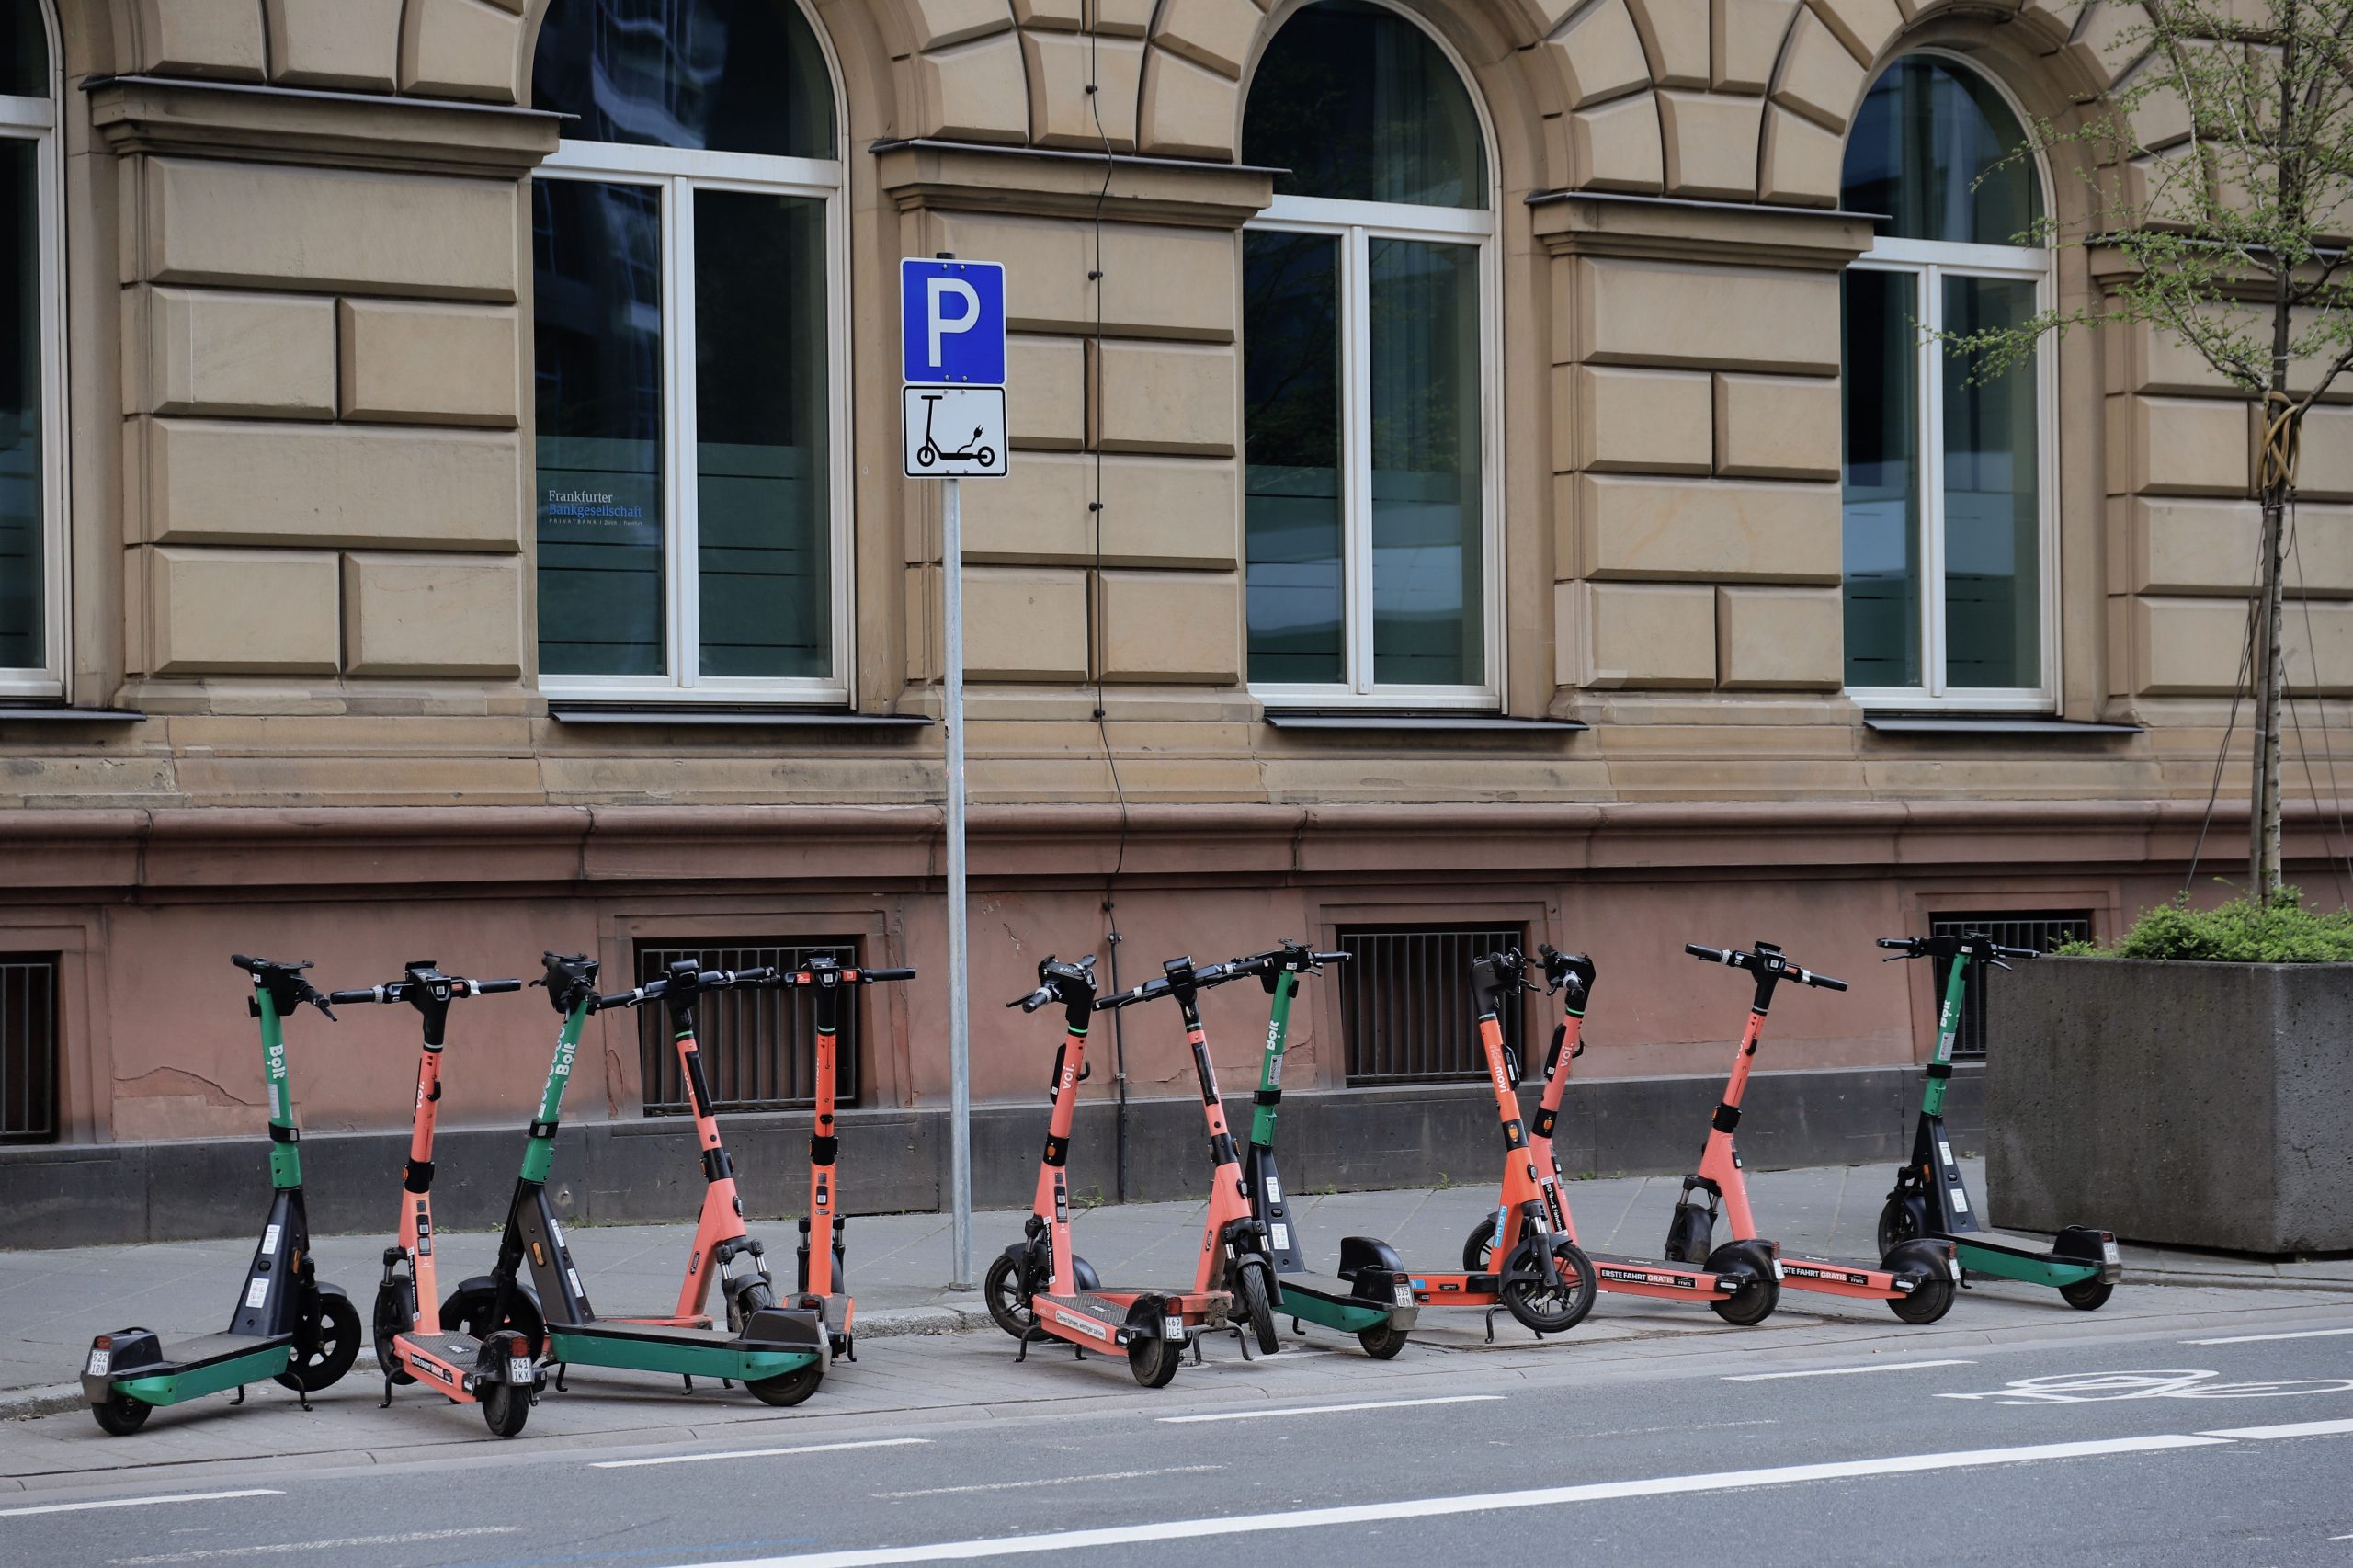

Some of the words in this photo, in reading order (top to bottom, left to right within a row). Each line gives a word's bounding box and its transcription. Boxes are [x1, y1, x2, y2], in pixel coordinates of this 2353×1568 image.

[927, 277, 981, 367] P
[549, 490, 613, 504] Frankfurter
[549, 504, 642, 518] Bankgesellschaft
[1267, 1020, 1279, 1051] Bolt
[268, 1044, 286, 1079] Bolt
[555, 1042, 576, 1075] Bolt
[1560, 1042, 1574, 1067] voi.
[1063, 1063, 1075, 1089] voi.
[1553, 1210, 1563, 1232] Fahrten
[1601, 1269, 1623, 1278] ERSTE
[1623, 1272, 1646, 1281] FAHRT
[1647, 1274, 1675, 1283] GRATIS
[1796, 1268, 1820, 1278] FAHRT
[1820, 1271, 1847, 1281] GRATIS
[1397, 1288, 1408, 1296] 315
[1167, 1318, 1180, 1327] 469
[94, 1353, 107, 1362] 922
[513, 1360, 528, 1369] 241
